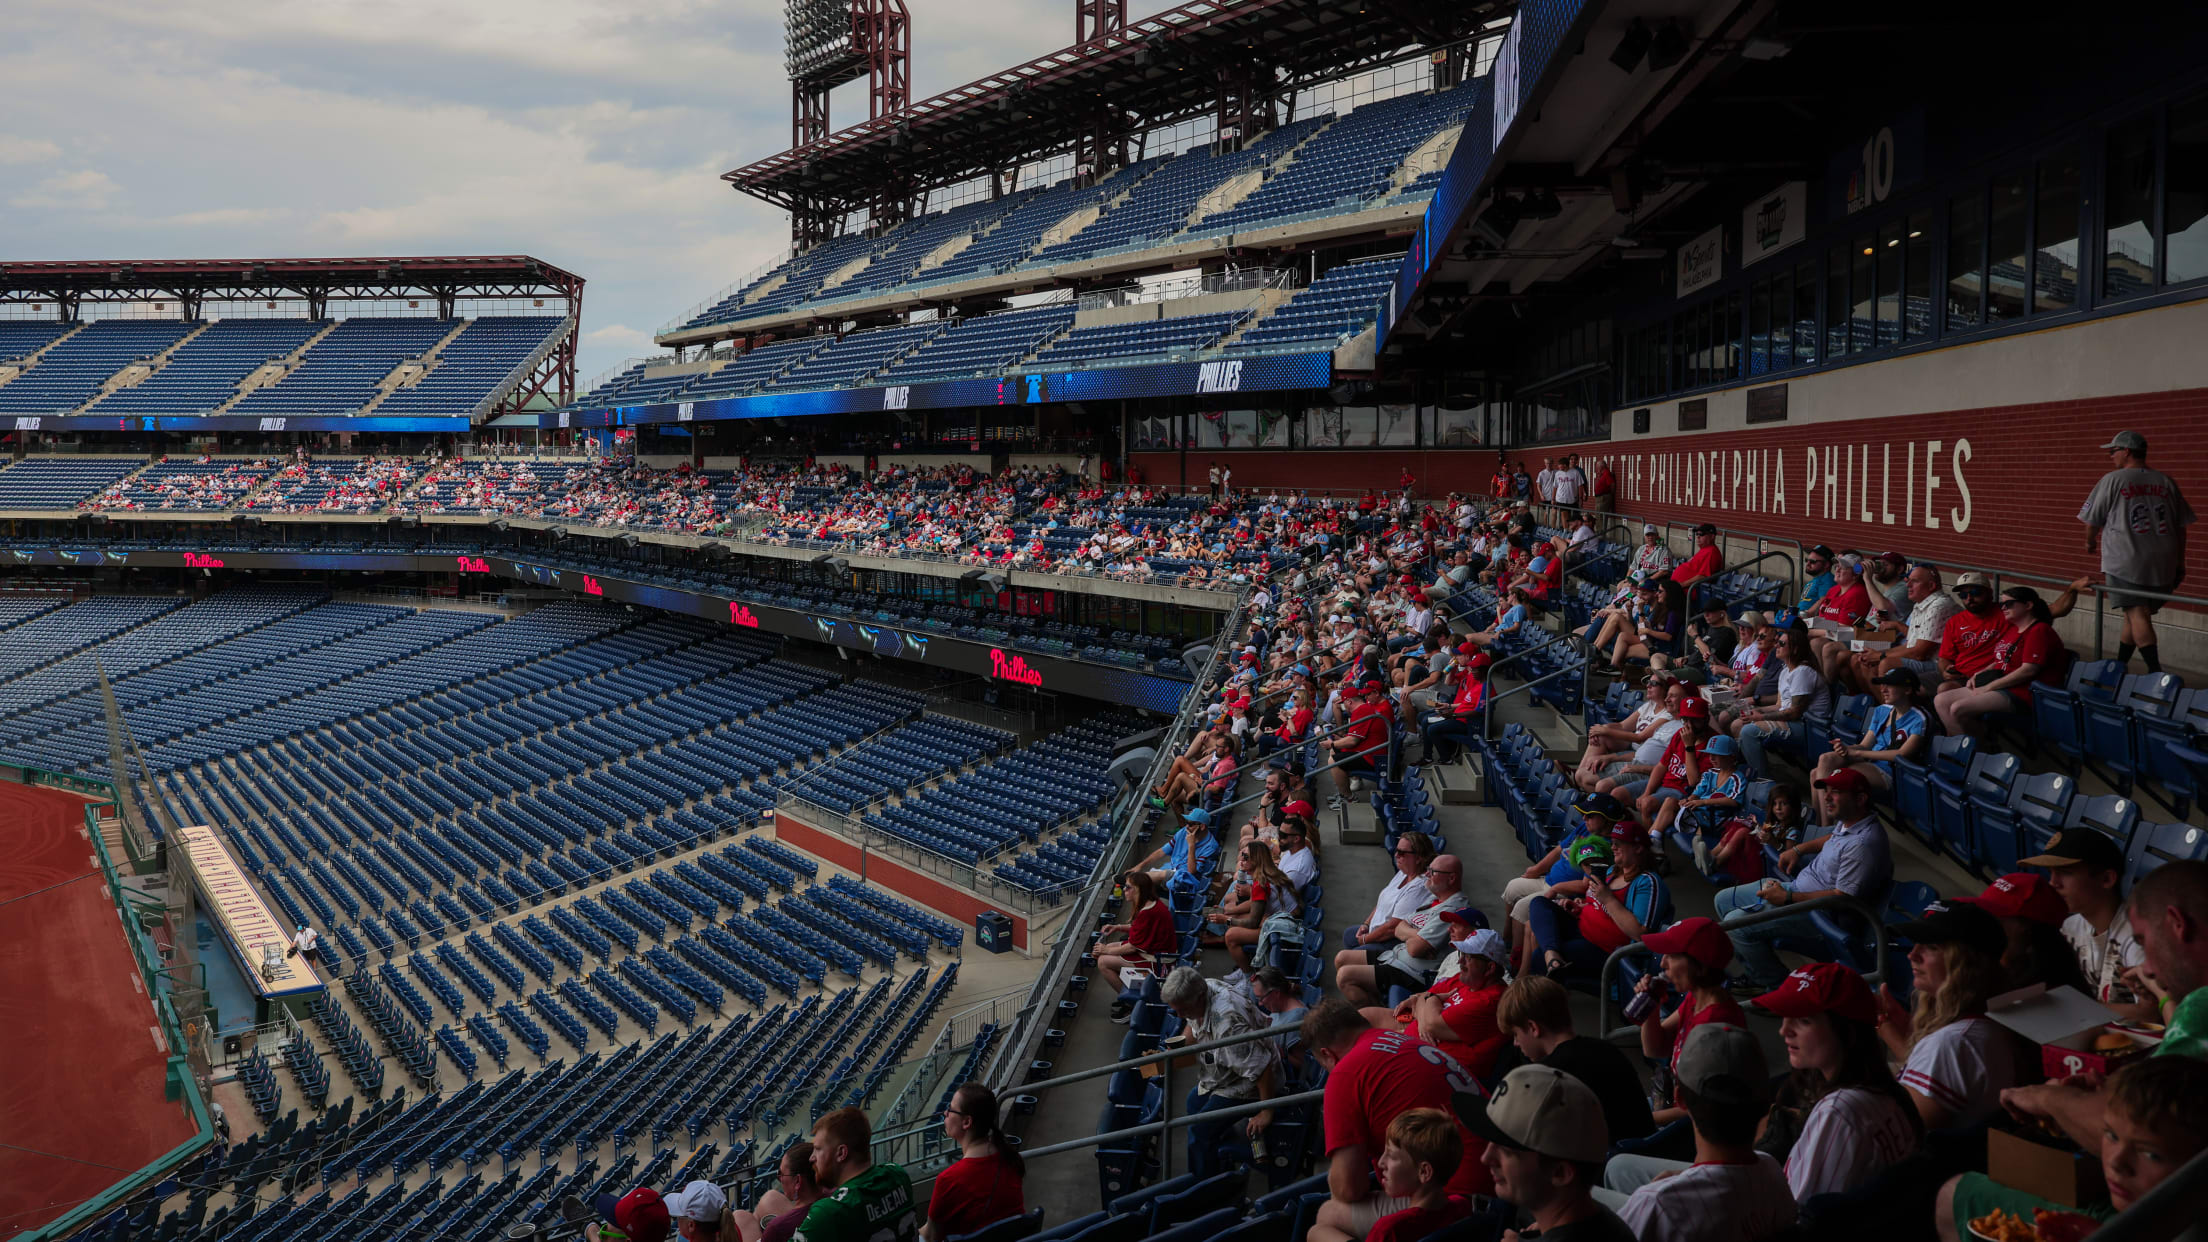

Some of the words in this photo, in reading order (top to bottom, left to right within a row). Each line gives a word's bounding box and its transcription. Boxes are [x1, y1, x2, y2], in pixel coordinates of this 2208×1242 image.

[1862, 127, 1895, 207] 10
[1196, 360, 1242, 393] PHILLIES
[884, 387, 910, 410] PHILLIES
[15, 417, 41, 431] PHILLIES
[259, 417, 287, 431] PHILLIES
[1621, 455, 1642, 501] THE
[1650, 448, 1786, 515] PHILADELPHIA
[1806, 438, 1972, 534] PHILLIES
[183, 552, 224, 568] Phillies
[729, 601, 758, 629] Phillies
[989, 648, 1043, 687] Phillies
[2063, 1055, 2083, 1076] P
[865, 1184, 908, 1223] DeJEAN
